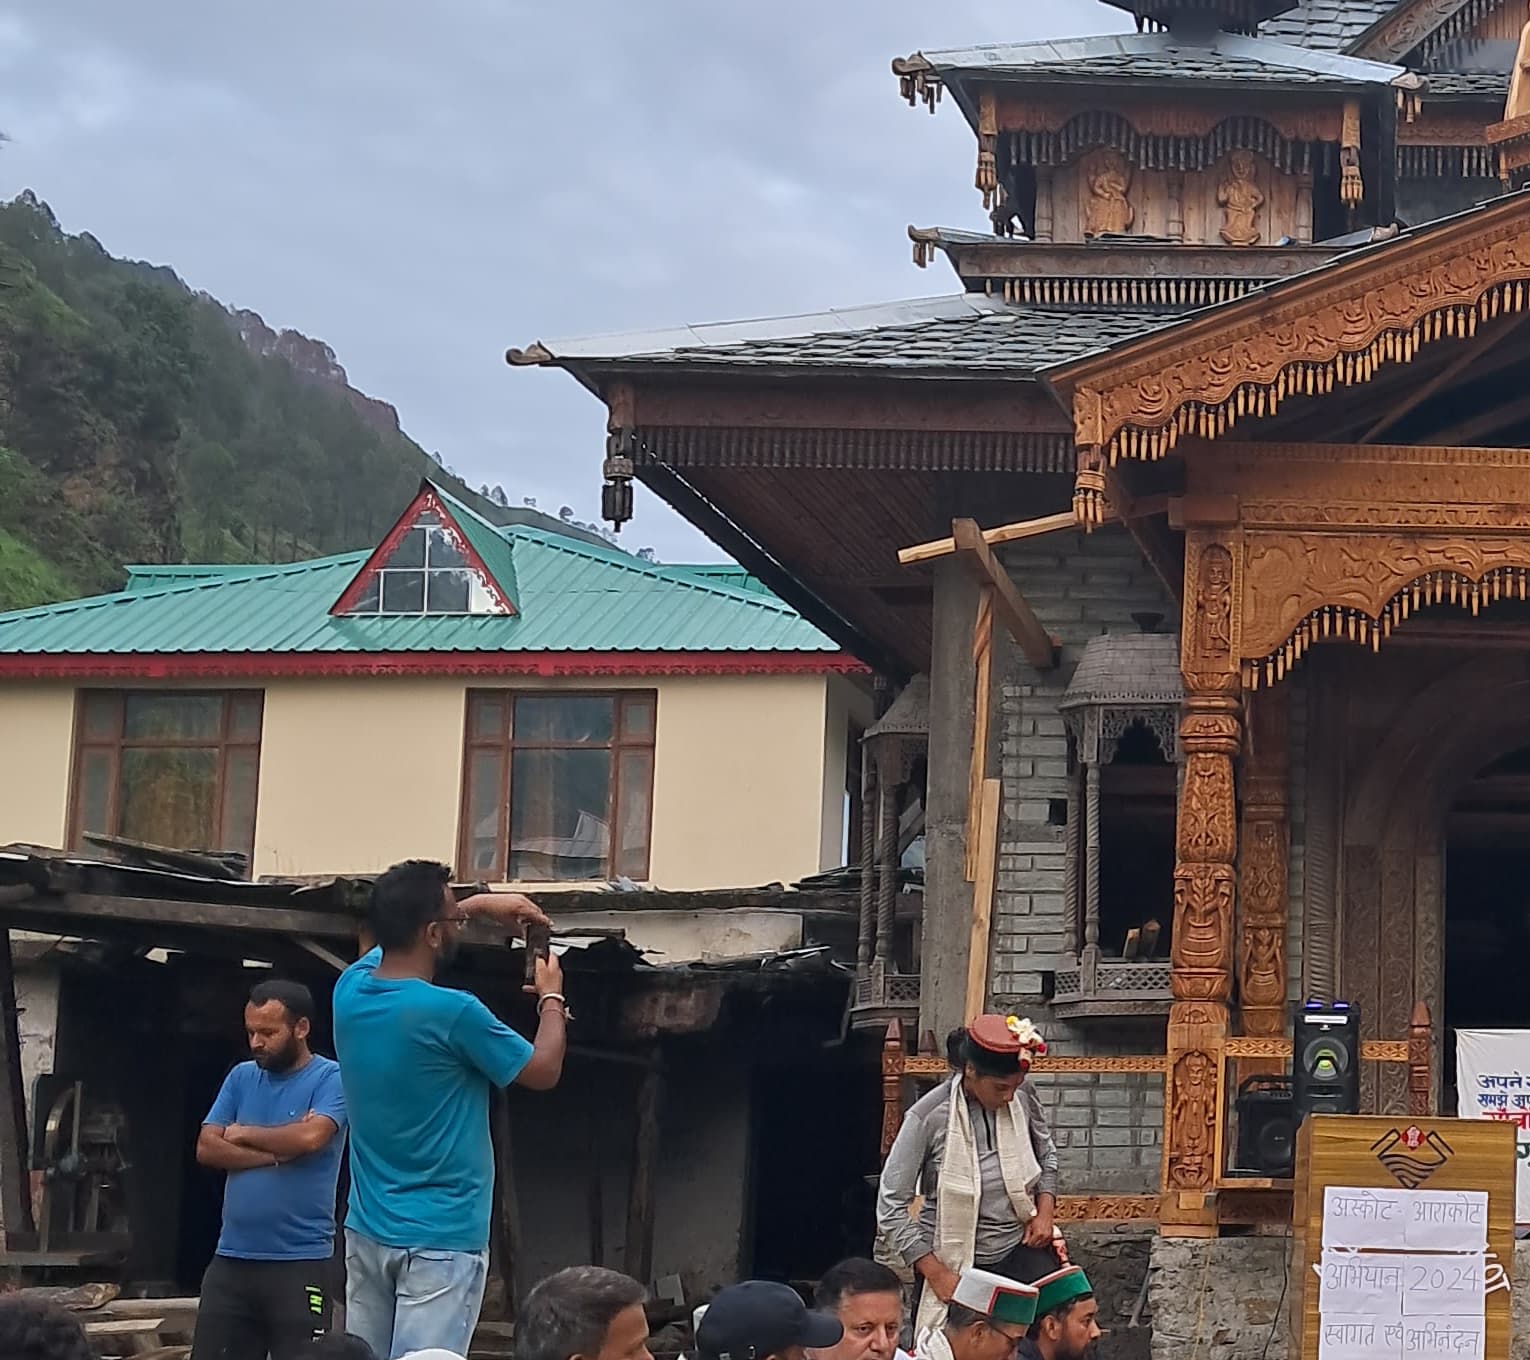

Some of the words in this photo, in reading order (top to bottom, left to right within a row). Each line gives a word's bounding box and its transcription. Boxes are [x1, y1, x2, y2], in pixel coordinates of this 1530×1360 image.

[1477, 1071, 1522, 1089] अपने
[1413, 1193, 1484, 1224] आराकोट
[1325, 1256, 1401, 1293] अभियान
[1409, 1264, 1481, 1291] 2024
[1325, 1324, 1375, 1346] स्वागत
